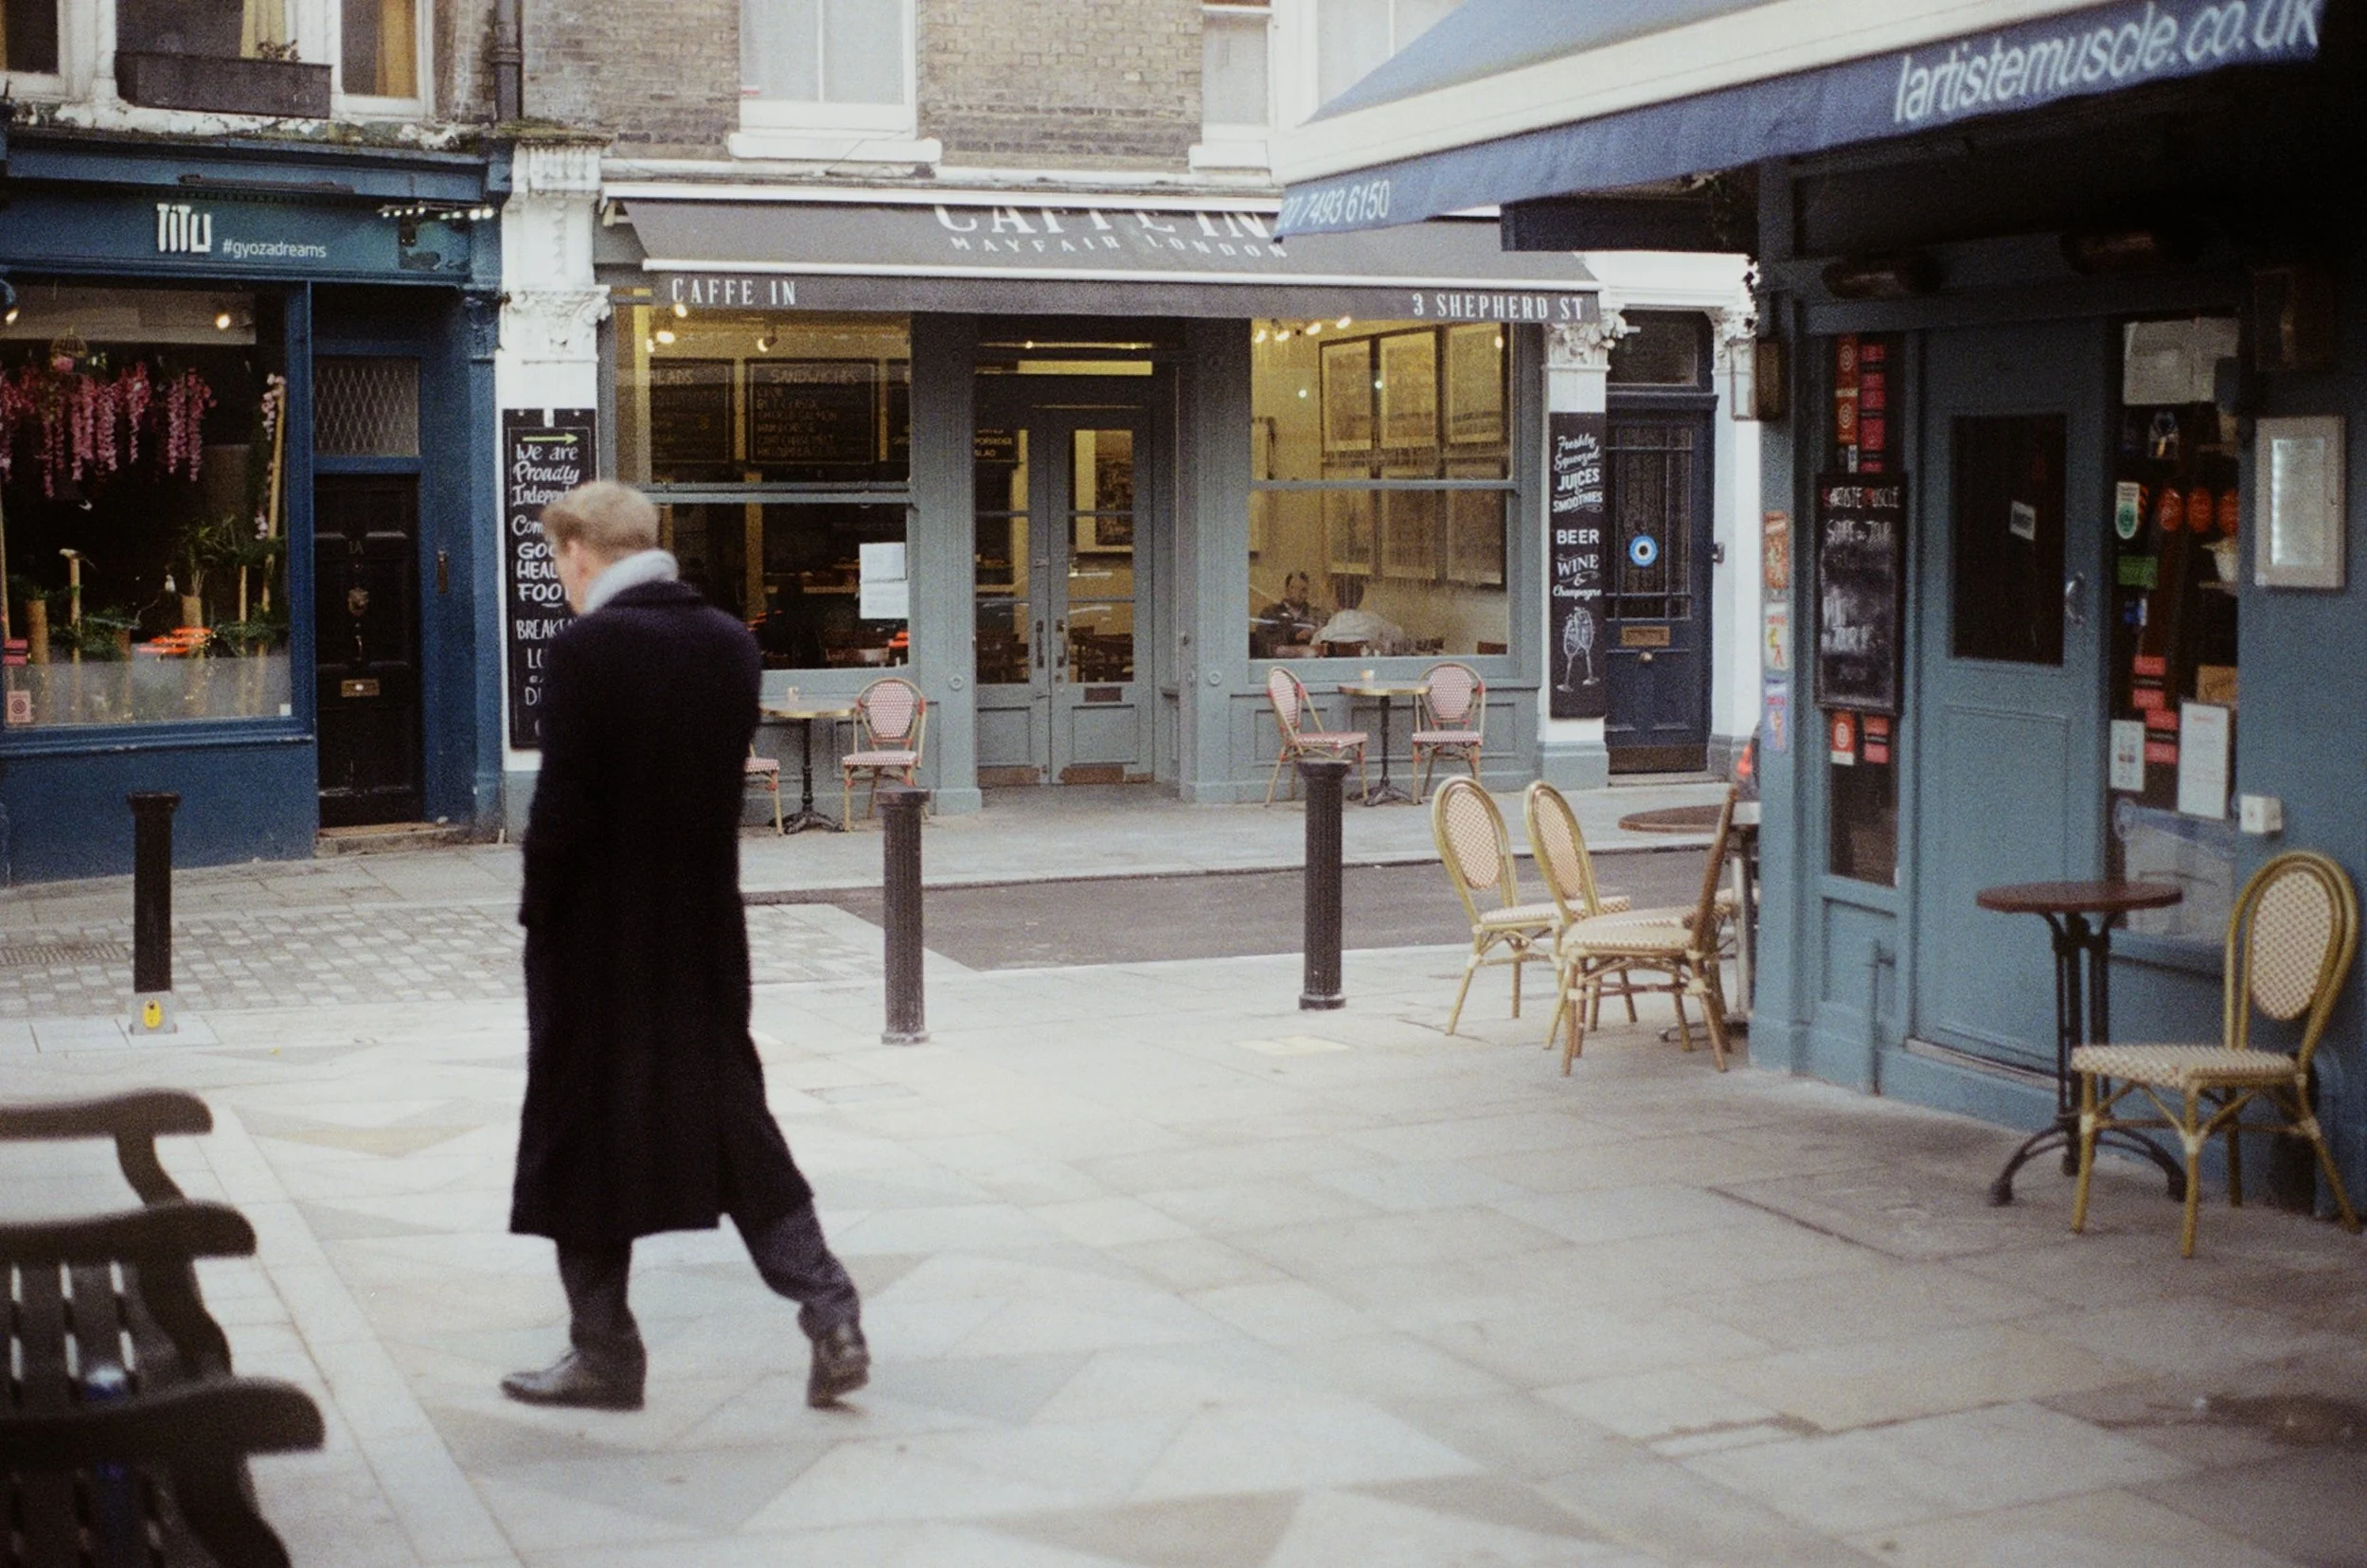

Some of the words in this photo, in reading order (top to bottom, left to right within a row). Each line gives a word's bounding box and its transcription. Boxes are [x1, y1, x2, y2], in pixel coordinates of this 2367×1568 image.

[1297, 187, 1346, 226] 7493
[1345, 179, 1391, 223] 6150
[222, 238, 328, 259] #gyozadreams
[950, 236, 1121, 253] MAYFAIR
[1145, 233, 1288, 258] LONDON
[671, 277, 755, 306] CAFFE
[770, 279, 796, 306] IN
[1412, 292, 1425, 317] 3
[1435, 294, 1549, 320] SHEPHERD
[1558, 295, 1584, 321] ST
[516, 443, 543, 461] We
[549, 445, 579, 461] are
[513, 461, 580, 485] Proudly
[1557, 468, 1600, 491] JUICES
[1553, 490, 1603, 512] SMOOTHIES
[1557, 529, 1600, 545] BEER
[516, 561, 559, 579] HEAL
[1557, 554, 1600, 577] WINE
[518, 583, 569, 602] FOO
[1553, 584, 1602, 601] Champagne
